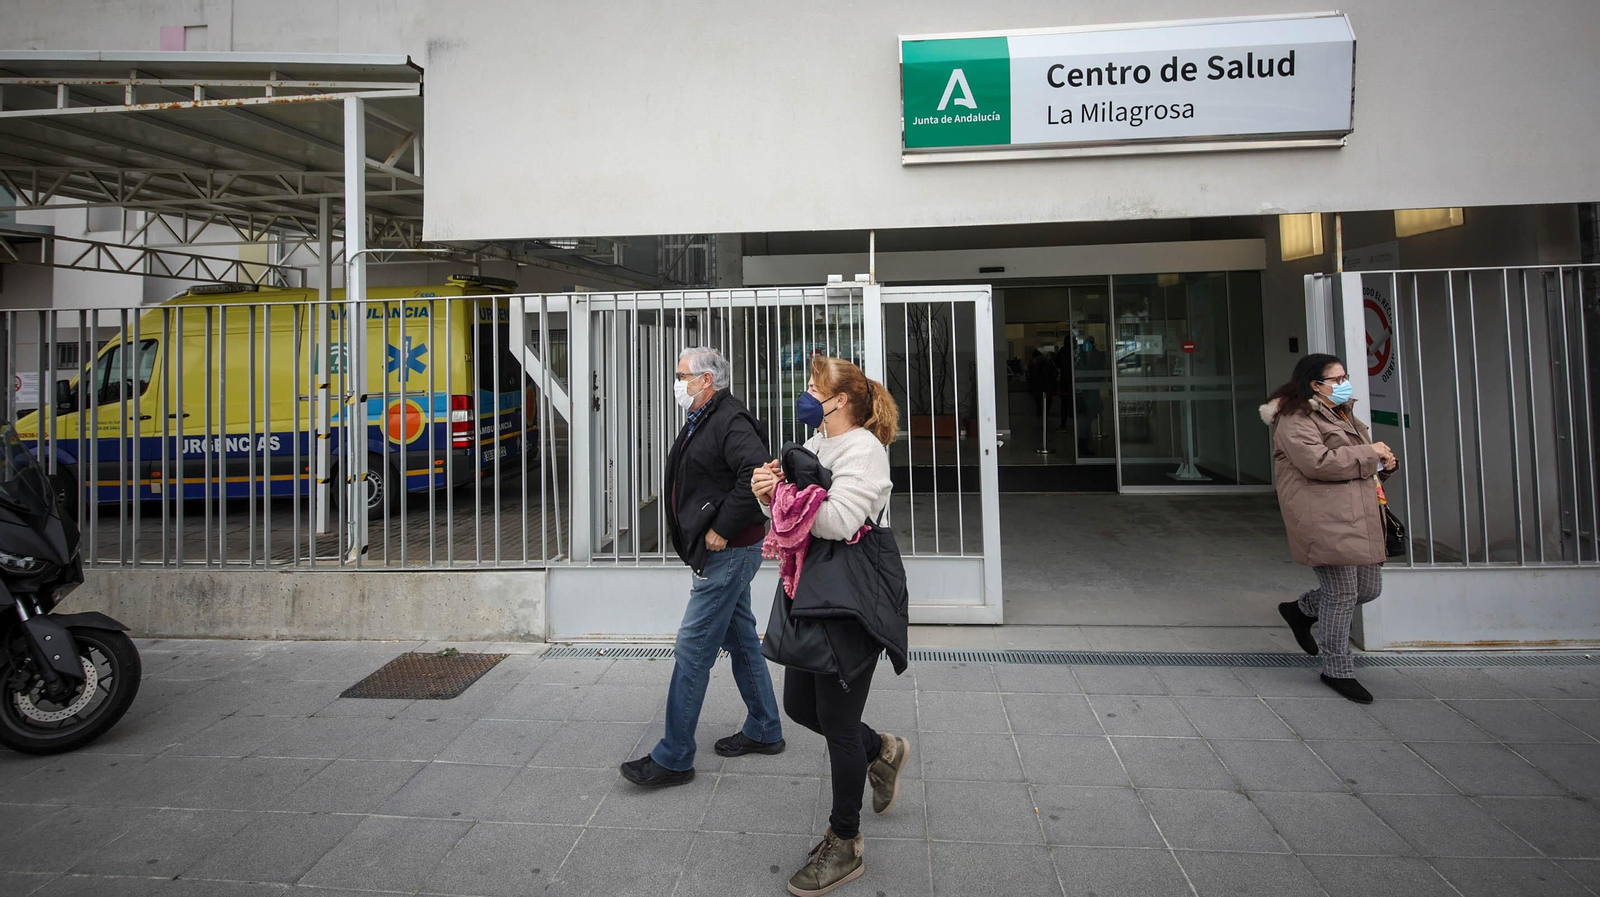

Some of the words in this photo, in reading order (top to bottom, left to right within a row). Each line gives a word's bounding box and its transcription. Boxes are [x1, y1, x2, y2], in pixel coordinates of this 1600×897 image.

[1047, 62, 1150, 88] Centro
[1160, 56, 1197, 82] de
[1207, 50, 1295, 80] Salud
[912, 115, 939, 126] Junta
[941, 114, 952, 124] de
[954, 111, 1001, 123] Andalucía
[1047, 104, 1072, 125] La
[1081, 101, 1194, 127] Milagrosa
